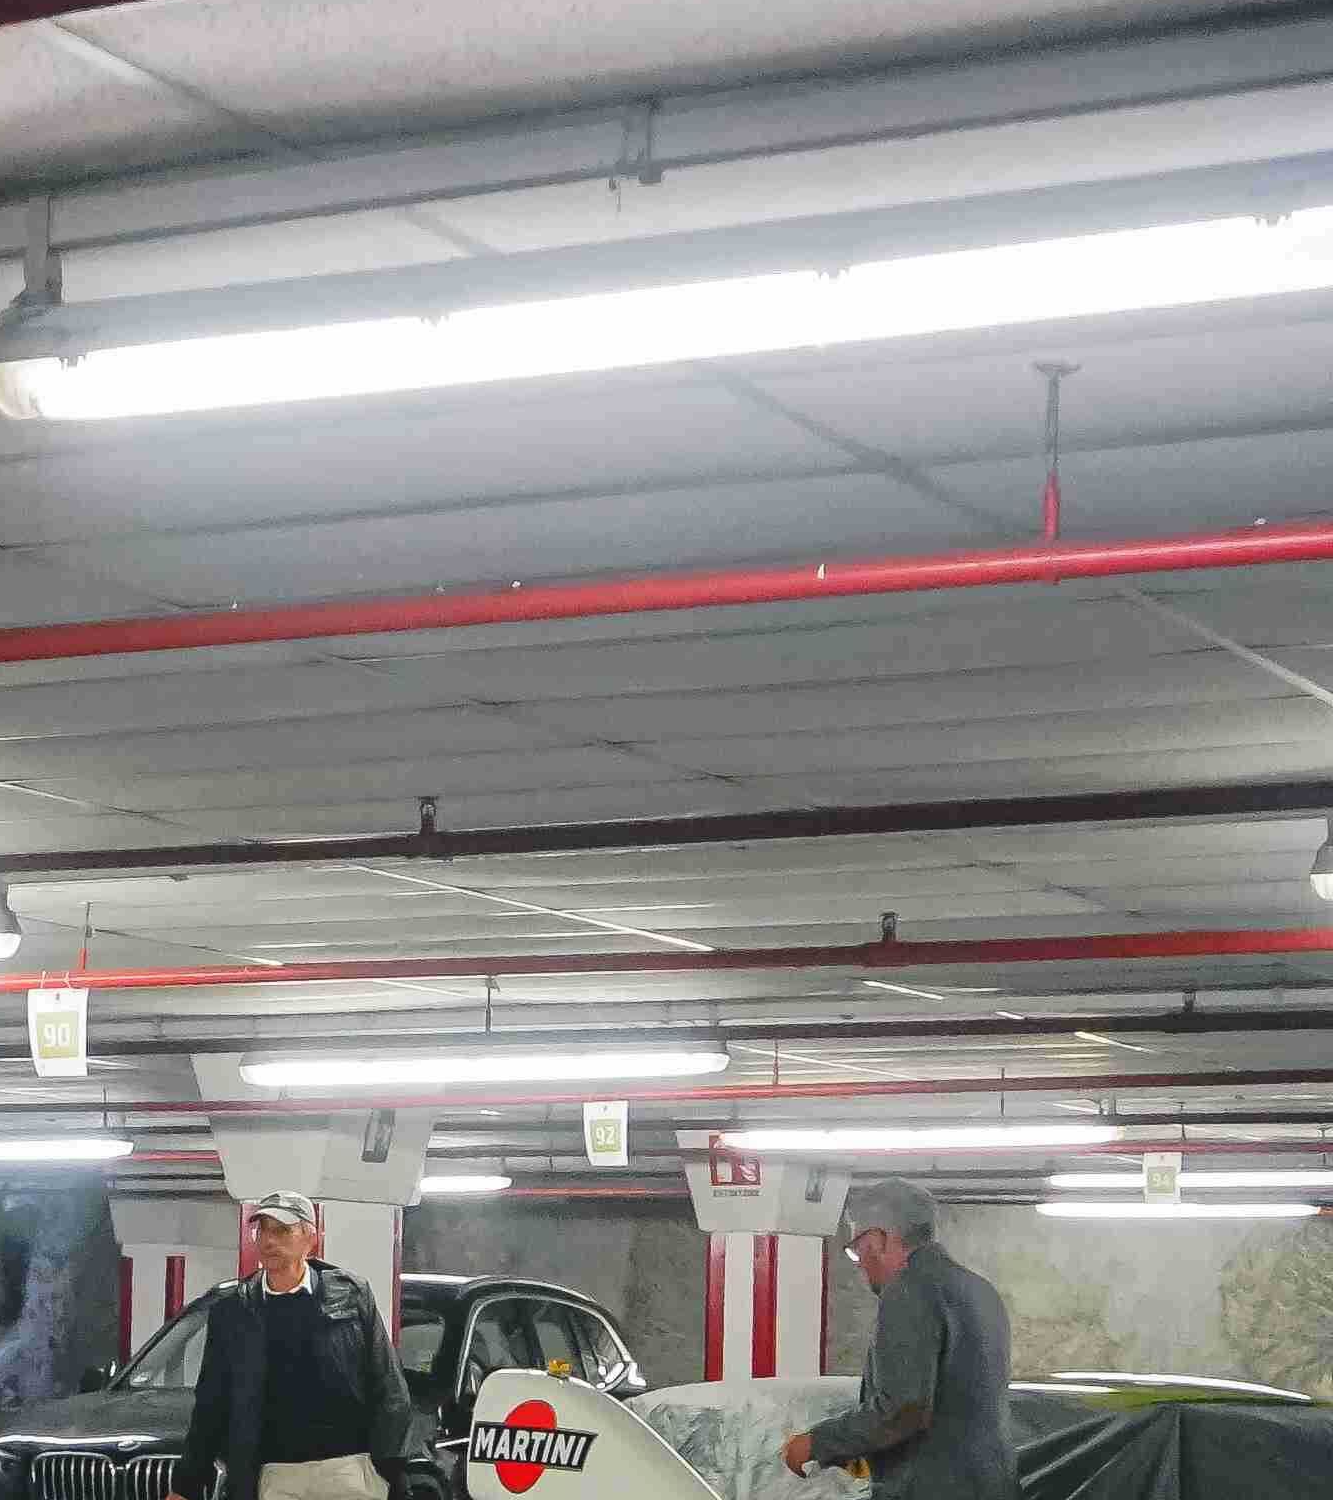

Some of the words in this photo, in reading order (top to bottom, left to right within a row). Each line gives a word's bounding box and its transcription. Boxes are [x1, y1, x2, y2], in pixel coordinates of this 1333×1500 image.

[44, 1023, 70, 1046] 90
[595, 1124, 615, 1145] 92
[473, 1426, 587, 1466] MARTINI
